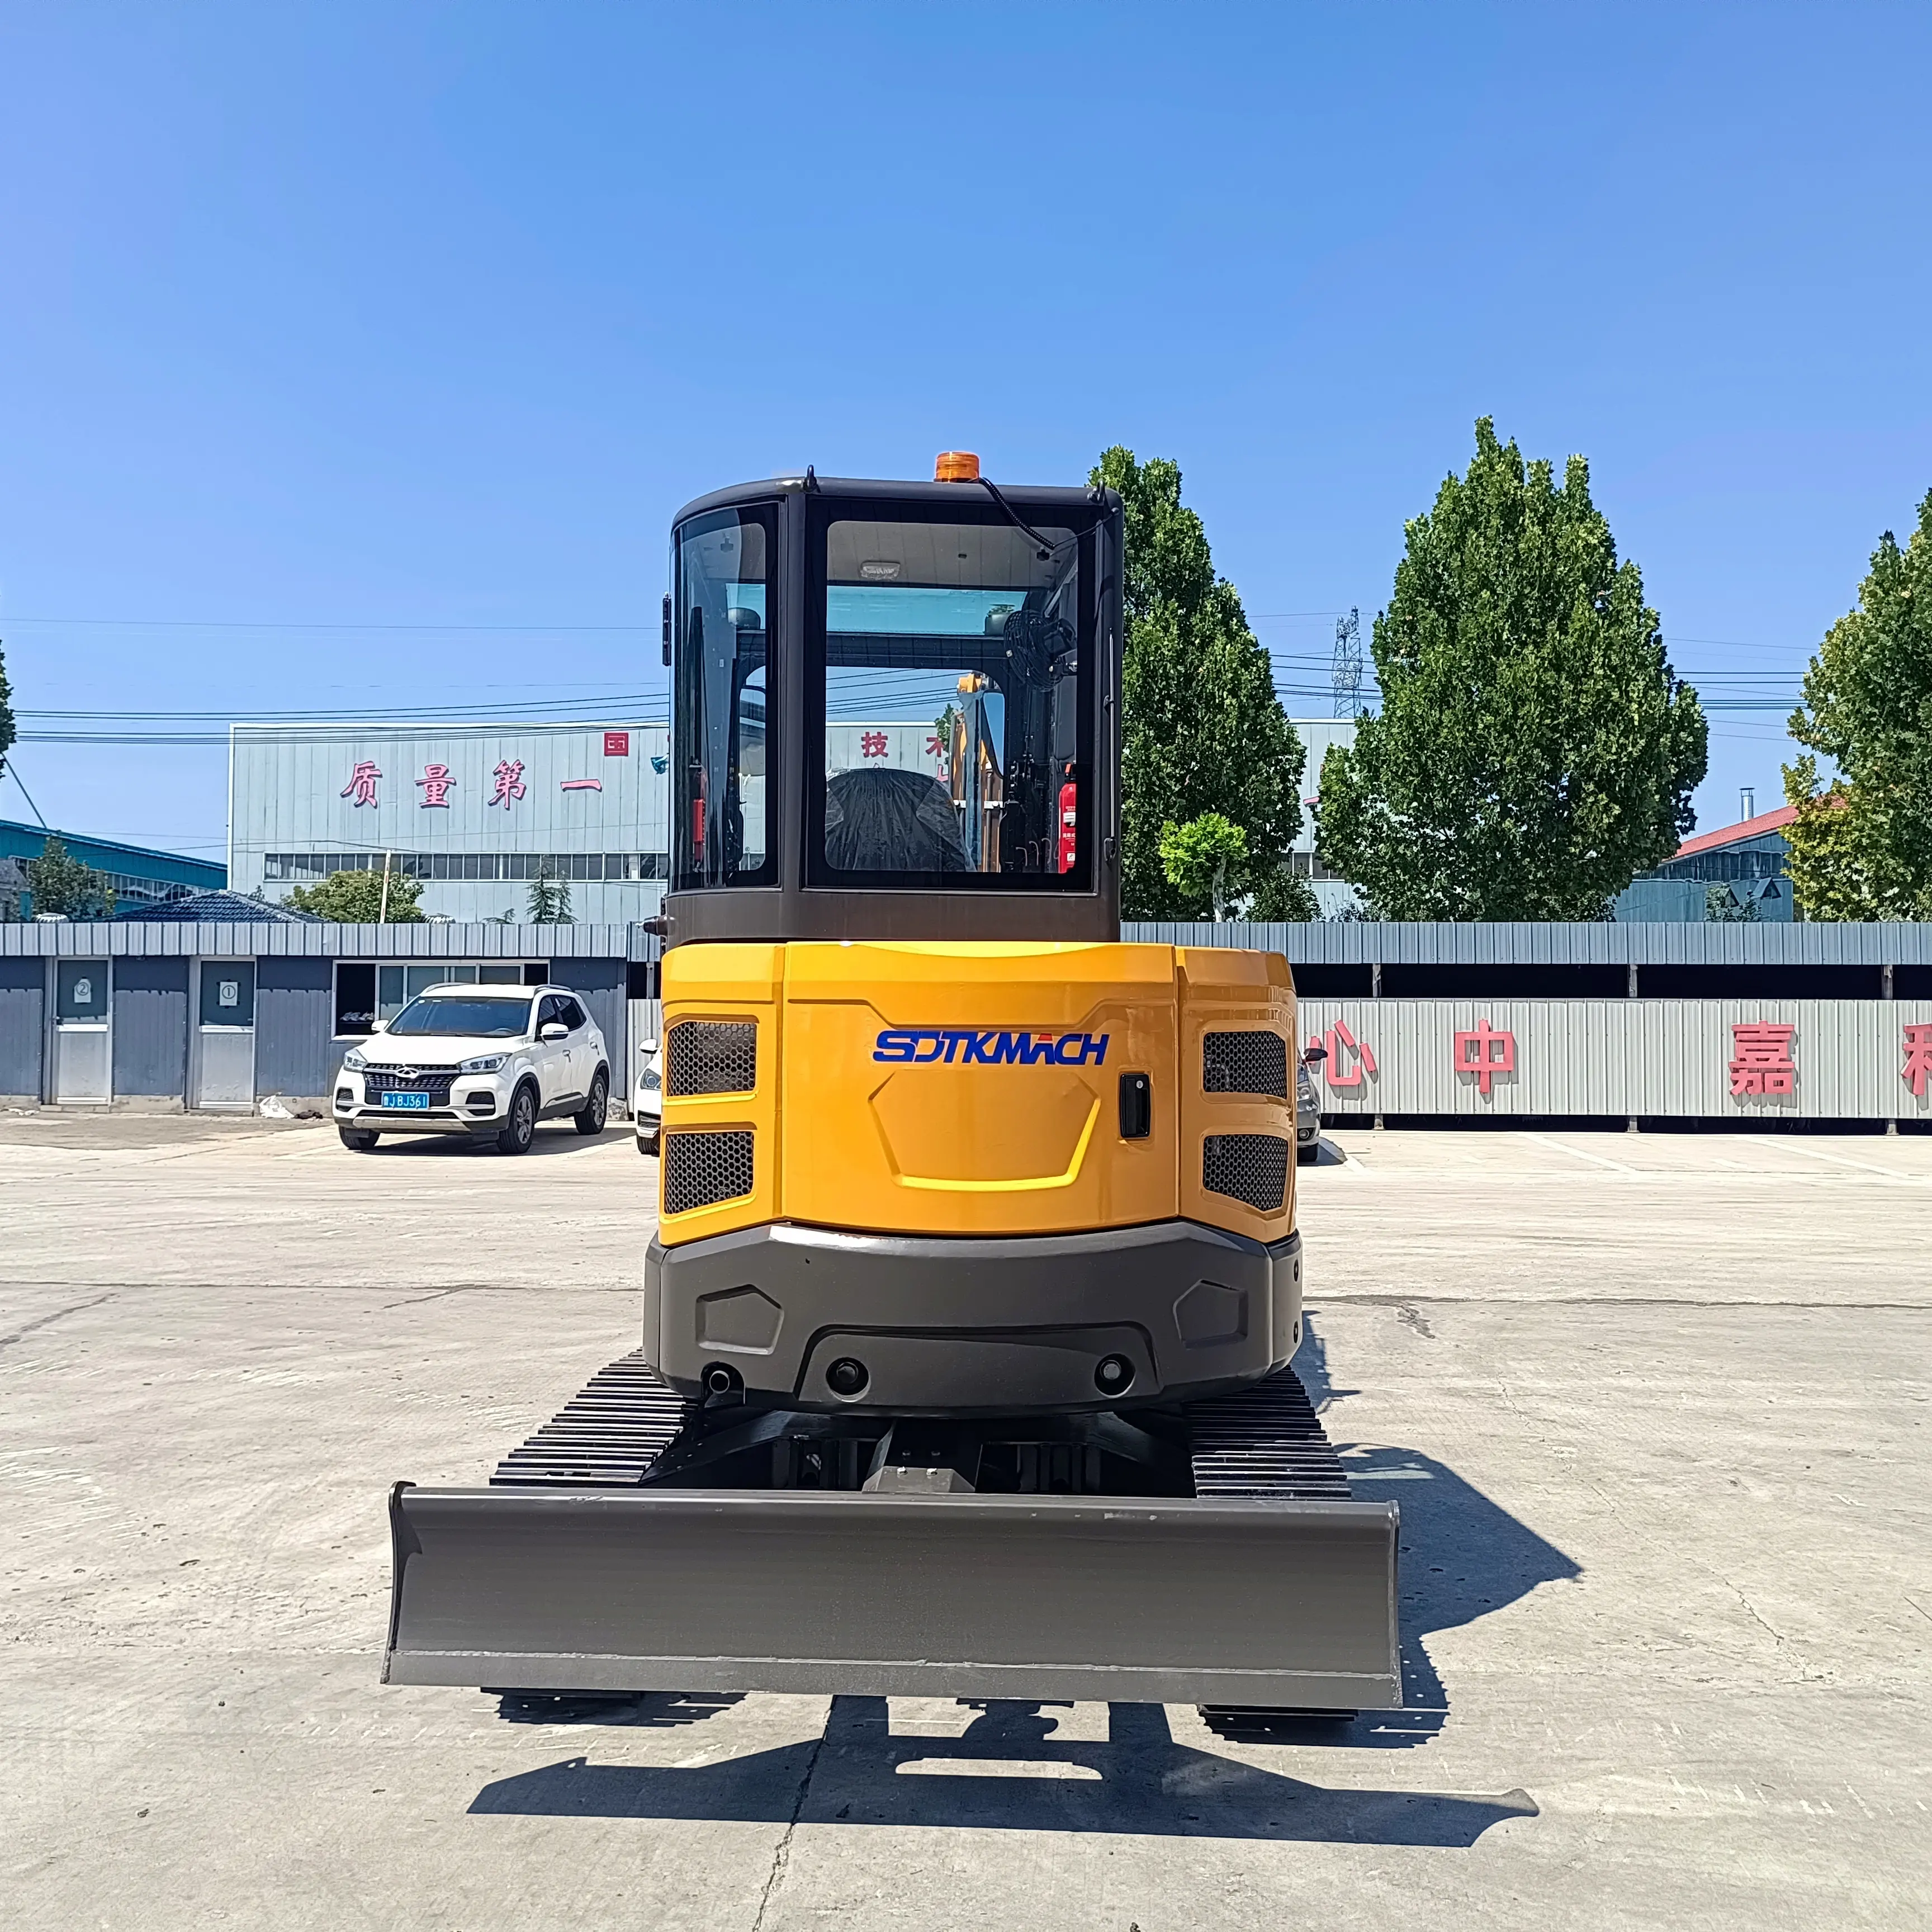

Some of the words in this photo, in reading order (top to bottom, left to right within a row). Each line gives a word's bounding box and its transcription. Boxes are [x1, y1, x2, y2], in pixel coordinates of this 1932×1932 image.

[340, 760, 602, 810] 质量第一
[383, 1095, 425, 1107] JBJ361
